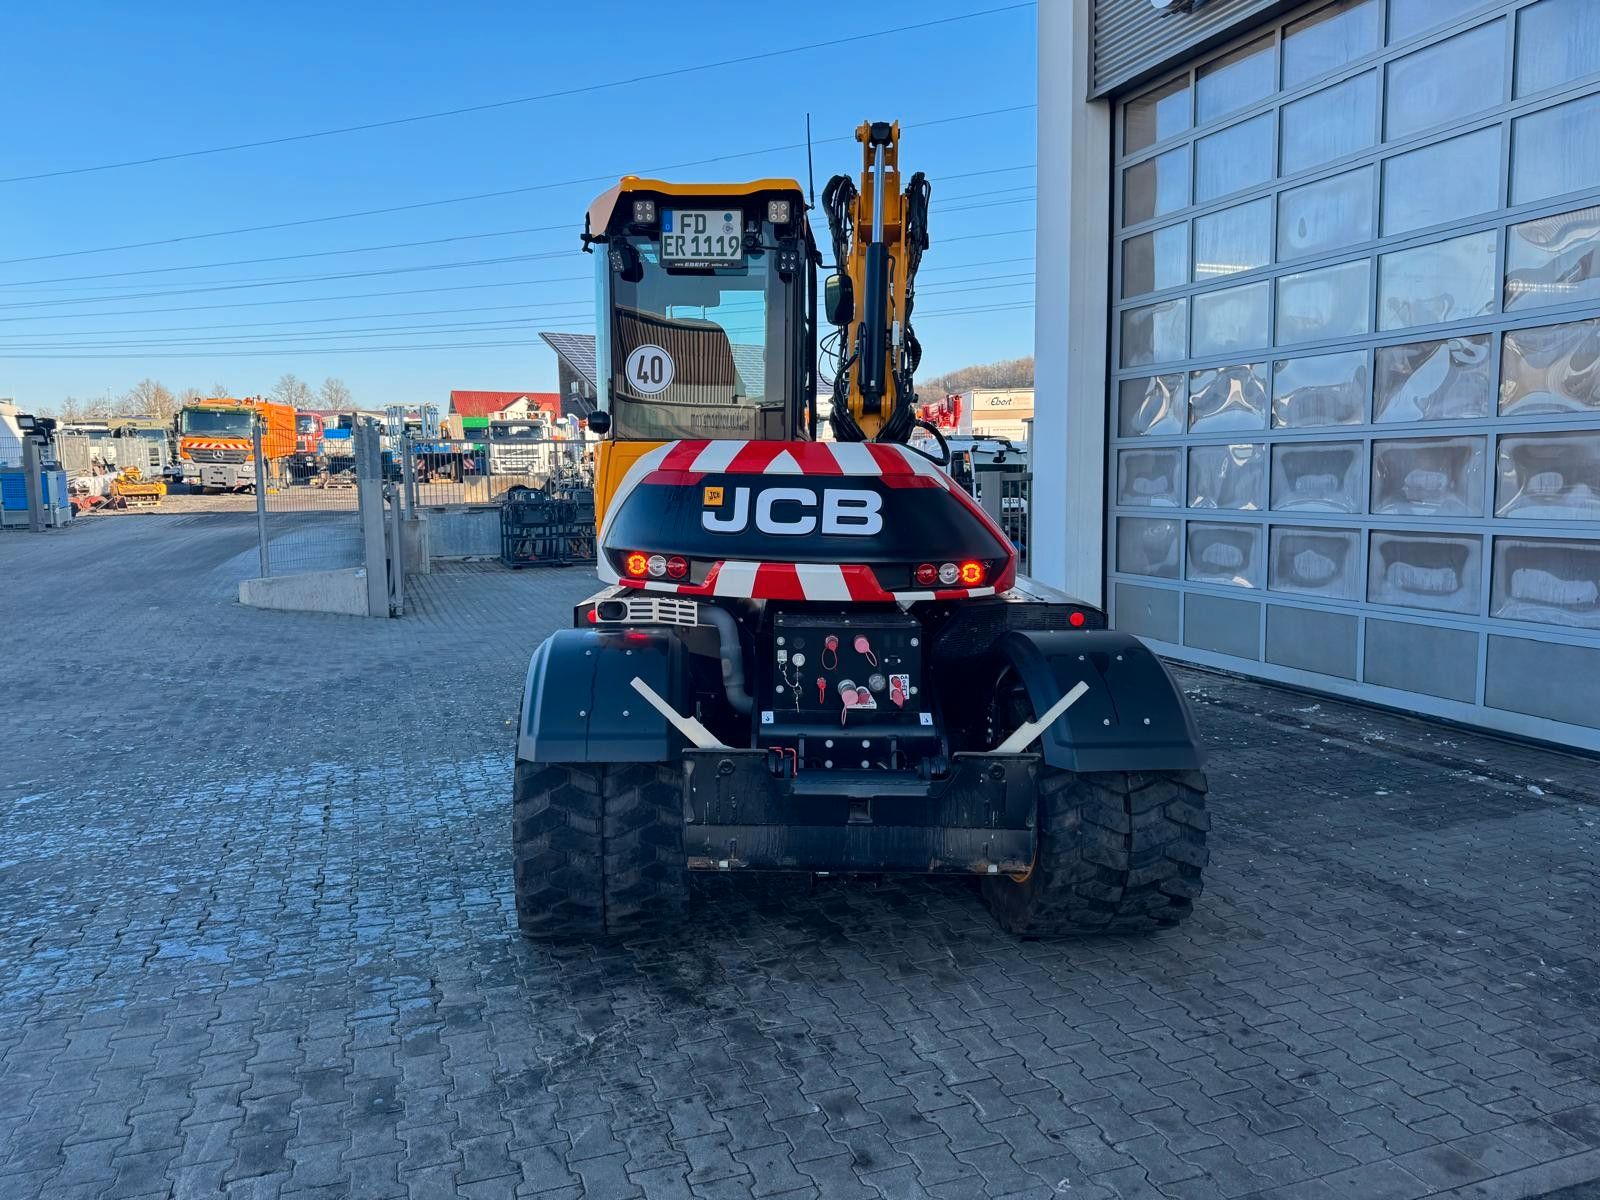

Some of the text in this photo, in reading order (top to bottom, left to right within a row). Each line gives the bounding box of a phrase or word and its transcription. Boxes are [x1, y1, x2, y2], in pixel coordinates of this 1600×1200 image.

[680, 213, 707, 234] FD
[663, 235, 740, 257] ER 1119
[636, 354, 664, 385] 40
[702, 487, 883, 536] JCB
